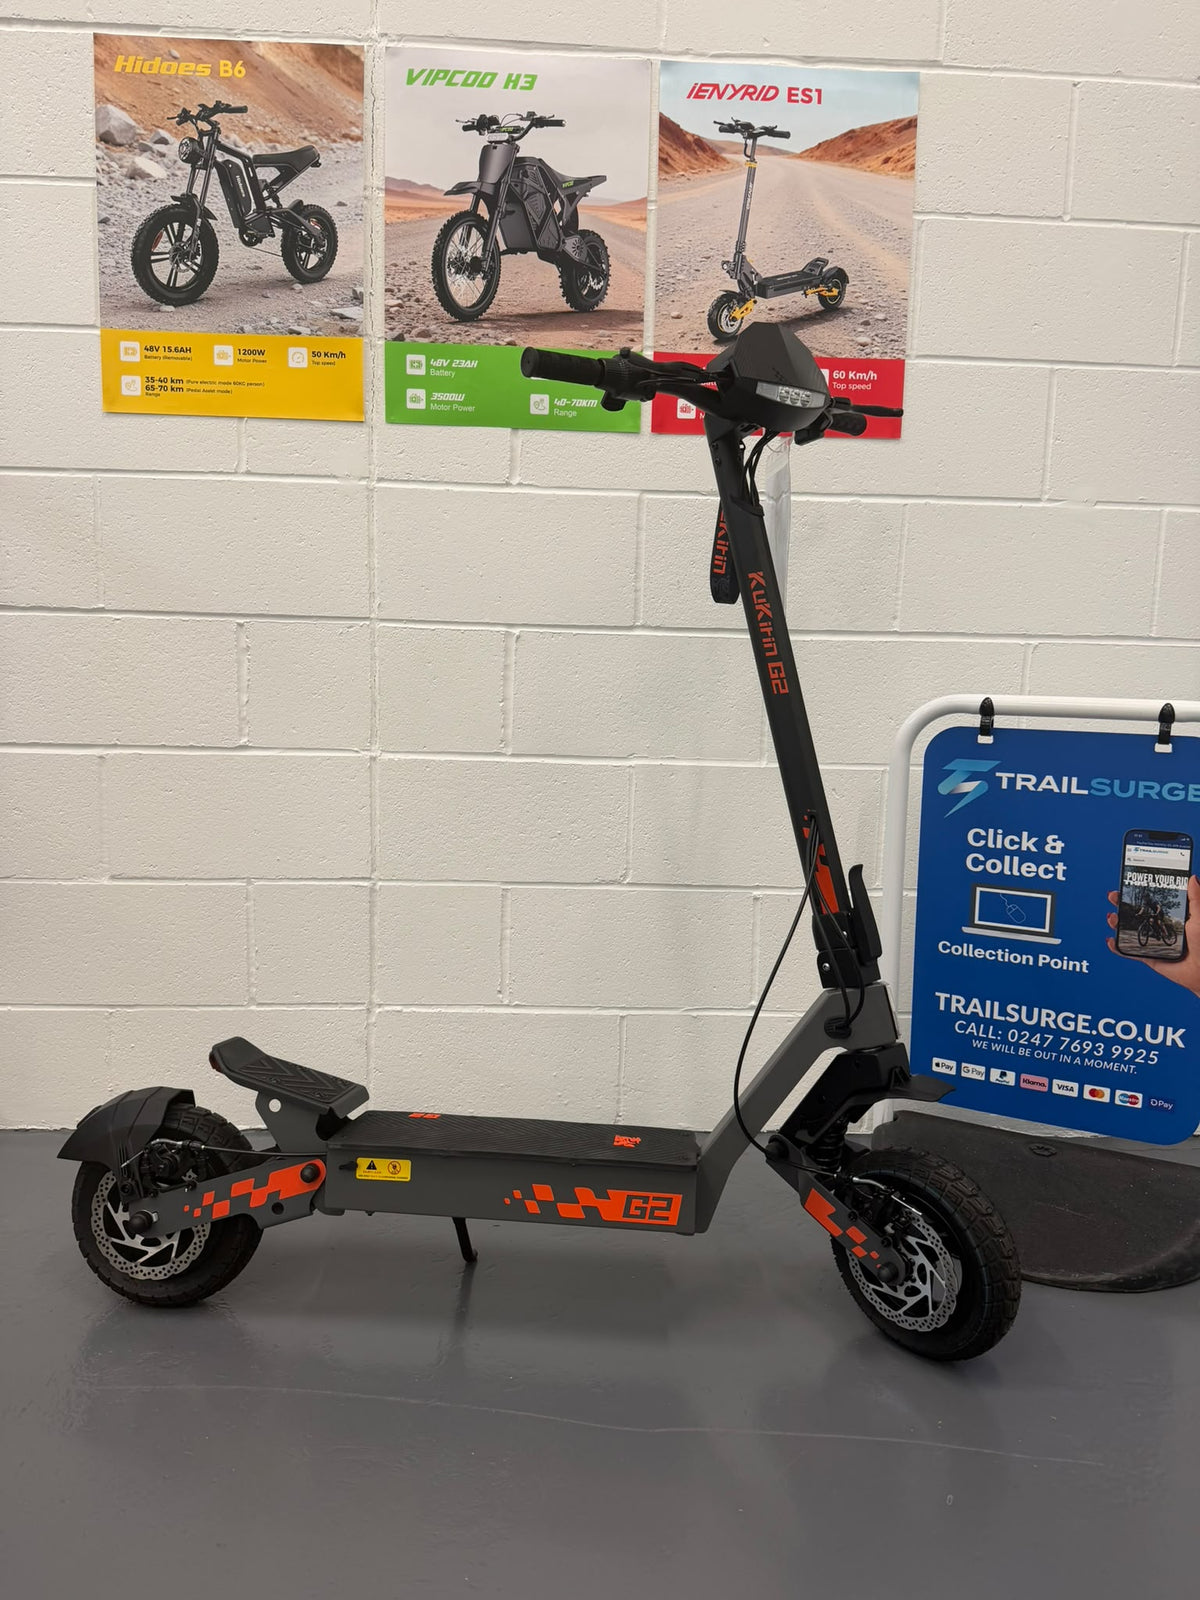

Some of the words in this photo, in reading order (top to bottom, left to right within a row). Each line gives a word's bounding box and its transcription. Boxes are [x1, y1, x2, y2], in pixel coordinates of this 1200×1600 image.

[114, 55, 212, 78] Hidoes
[219, 60, 246, 78] B6
[405, 68, 498, 88] VIPCOO
[503, 74, 538, 91] H3
[686, 82, 779, 102] iENYRID
[787, 87, 823, 105] ES1
[144, 345, 160, 353] 48V
[162, 346, 192, 354] 15.6AH
[237, 348, 266, 356] 1200W
[323, 351, 346, 360] Km/h
[430, 359, 449, 368] 48V
[452, 359, 478, 369] 23AH
[430, 368, 456, 378] Battery
[832, 370, 846, 380] 60
[848, 370, 878, 382] Km/h
[145, 376, 168, 384] 35-40
[145, 384, 168, 392] 65-70
[170, 385, 184, 393] km
[832, 382, 847, 390] Top
[848, 382, 872, 391] speed
[430, 392, 465, 402] 3500W
[430, 403, 452, 412] Motor
[453, 404, 476, 413] Power
[553, 408, 578, 418] Range
[767, 661, 789, 695] G2
[995, 772, 1200, 802] TRAILSURGE
[967, 828, 1039, 853] Click
[1044, 834, 1065, 855] &
[965, 852, 1067, 881] Collect
[1127, 871, 1153, 883] POWER
[1154, 874, 1174, 886] YOUR
[938, 940, 1034, 966] Collection
[1038, 953, 1090, 974] Point
[934, 992, 1187, 1049] TRAILSURGE.CO.UK
[954, 1020, 1003, 1040] CALL:
[1007, 1029, 1054, 1048] 0247
[1059, 1036, 1105, 1056] 7693
[1110, 1045, 1159, 1065] 9925
[972, 1039, 989, 1050] WE
[991, 1042, 1016, 1055] WILL
[1018, 1047, 1032, 1057] BE
[1034, 1049, 1058, 1062] OUT
[1059, 1053, 1072, 1064] IN
[1073, 1056, 1082, 1065] A
[1084, 1057, 1138, 1075] MOMENT.
[940, 1062, 954, 1072] Pay
[971, 1067, 985, 1078] Pay
[1056, 1083, 1075, 1093] VISA
[622, 1194, 673, 1222] G2
